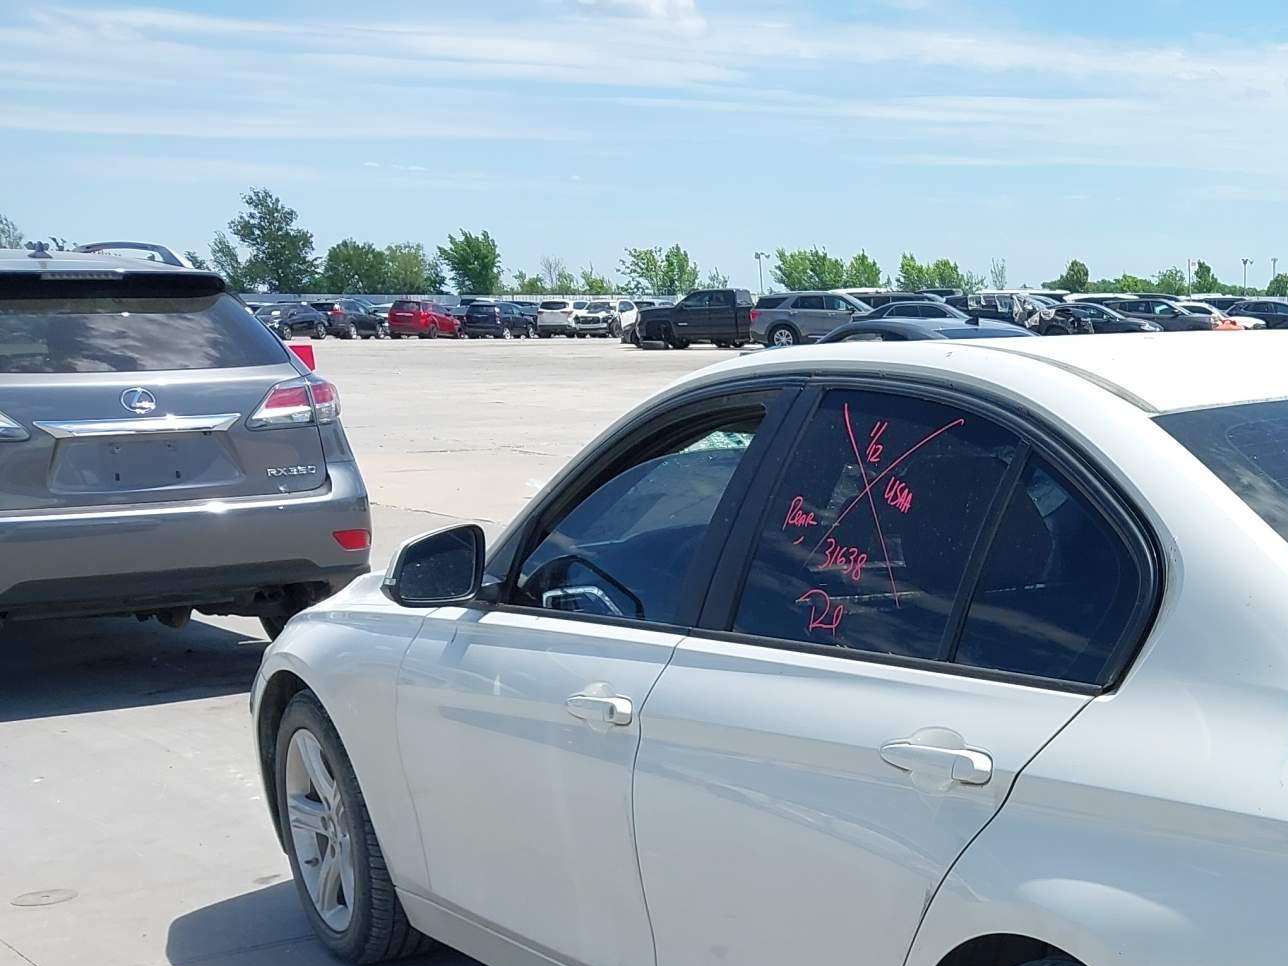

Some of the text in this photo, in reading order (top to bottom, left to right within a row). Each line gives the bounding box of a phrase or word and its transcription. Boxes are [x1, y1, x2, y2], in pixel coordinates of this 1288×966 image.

[266, 465, 317, 477] RX350
[884, 476, 913, 513] USAA
[818, 537, 867, 581] 31638
